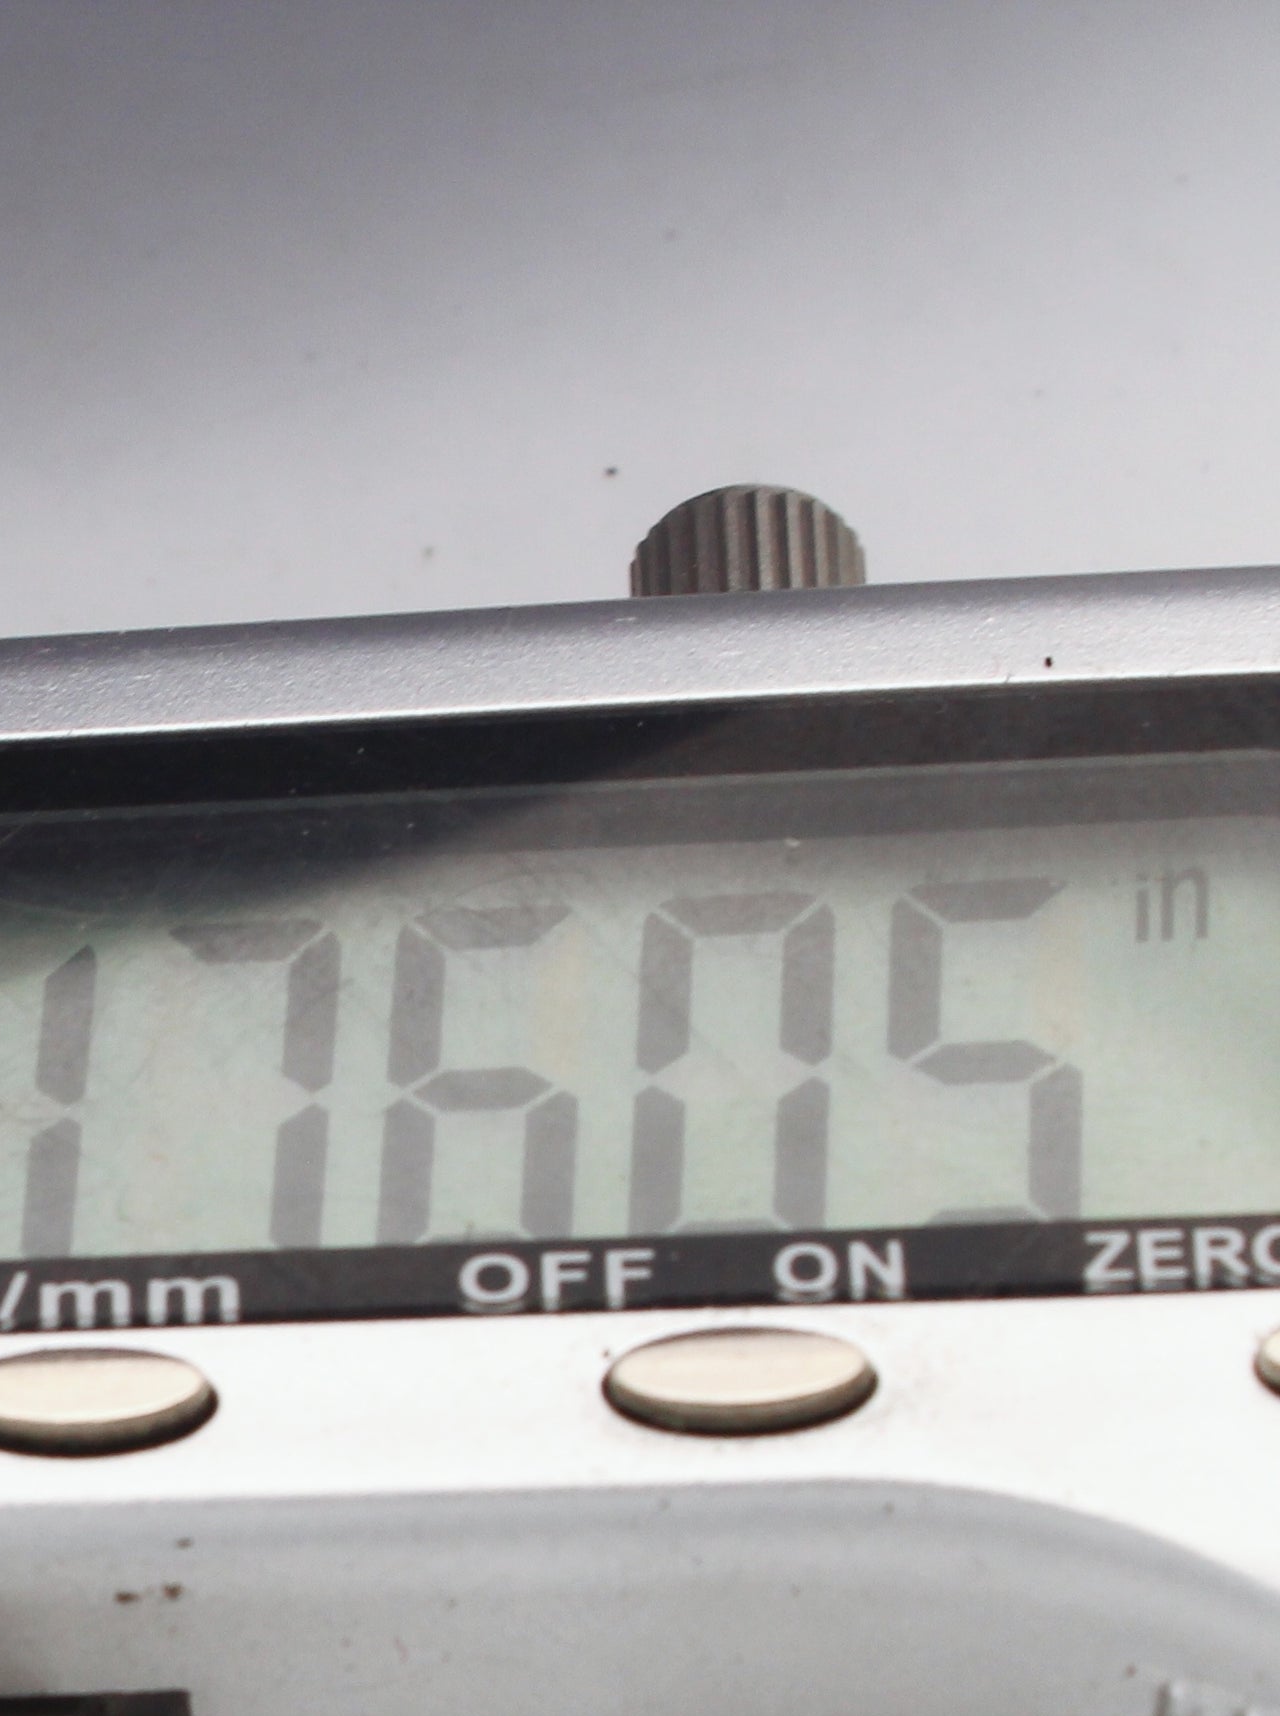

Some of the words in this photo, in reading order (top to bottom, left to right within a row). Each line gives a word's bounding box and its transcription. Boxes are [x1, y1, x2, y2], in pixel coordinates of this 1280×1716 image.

[1135, 866, 1208, 942] in
[458, 1249, 655, 1310] OFF
[773, 1241, 905, 1300] ON
